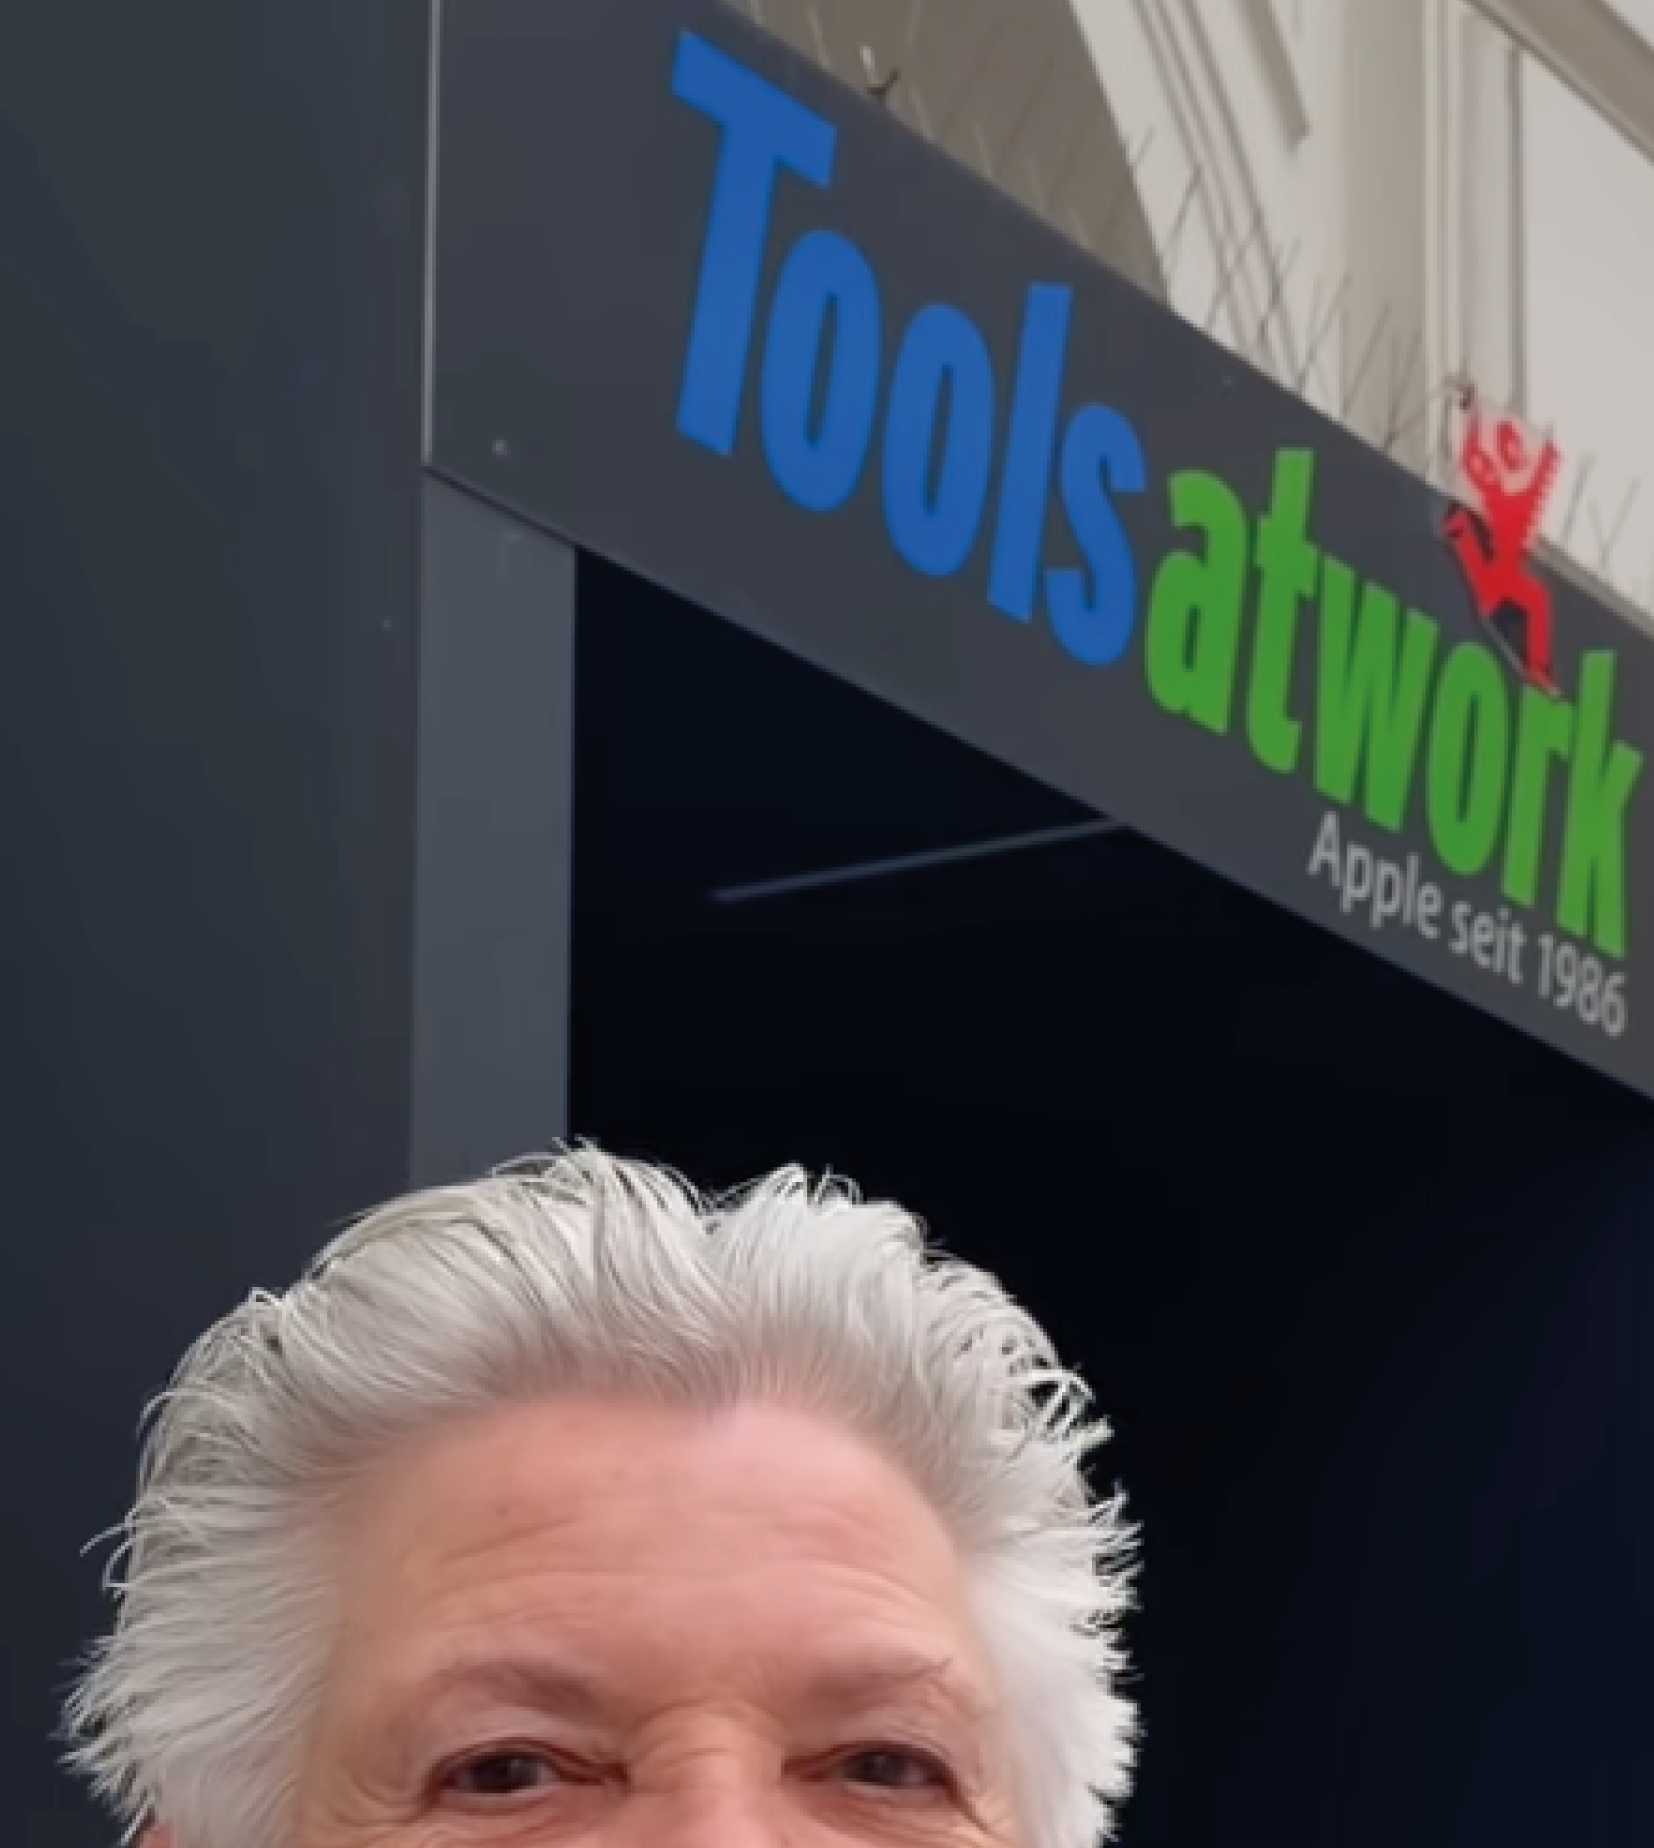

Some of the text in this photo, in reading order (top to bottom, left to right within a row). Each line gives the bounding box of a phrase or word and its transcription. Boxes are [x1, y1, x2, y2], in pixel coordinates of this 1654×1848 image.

[670, 30, 1642, 956] Toolsatwork
[1307, 808, 1627, 1038] Apple seit 1986
